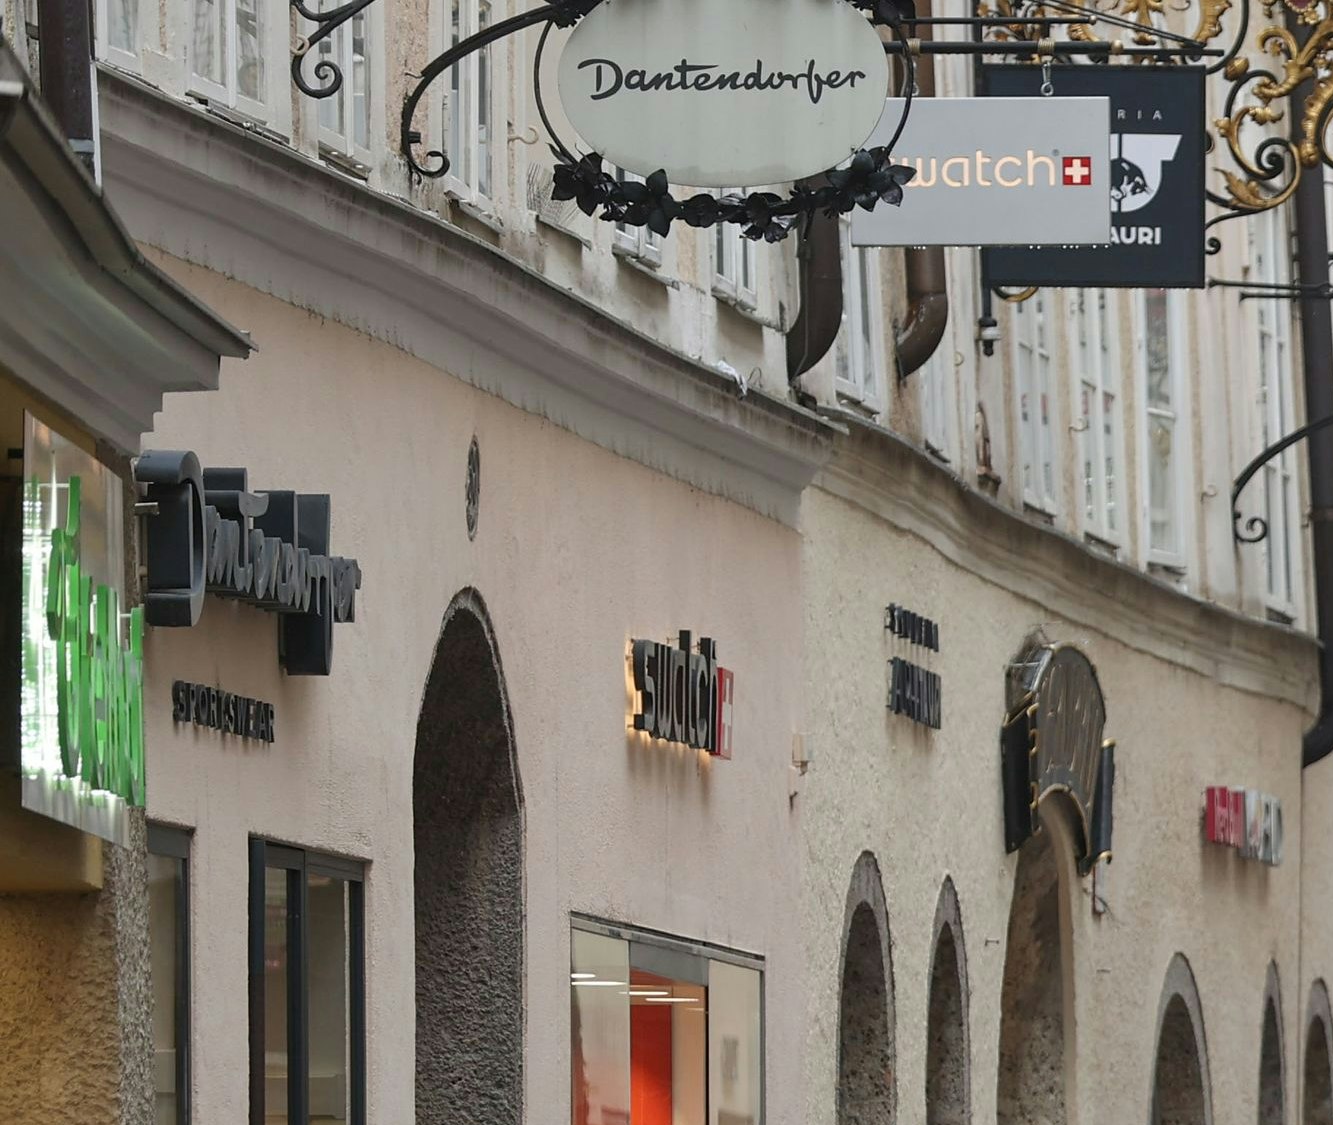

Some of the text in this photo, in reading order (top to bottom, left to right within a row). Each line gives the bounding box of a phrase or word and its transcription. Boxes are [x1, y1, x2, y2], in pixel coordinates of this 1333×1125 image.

[577, 58, 866, 104] Dantendorfer
[887, 149, 1056, 188] watch
[172, 680, 276, 744] SPORTSWEAR
